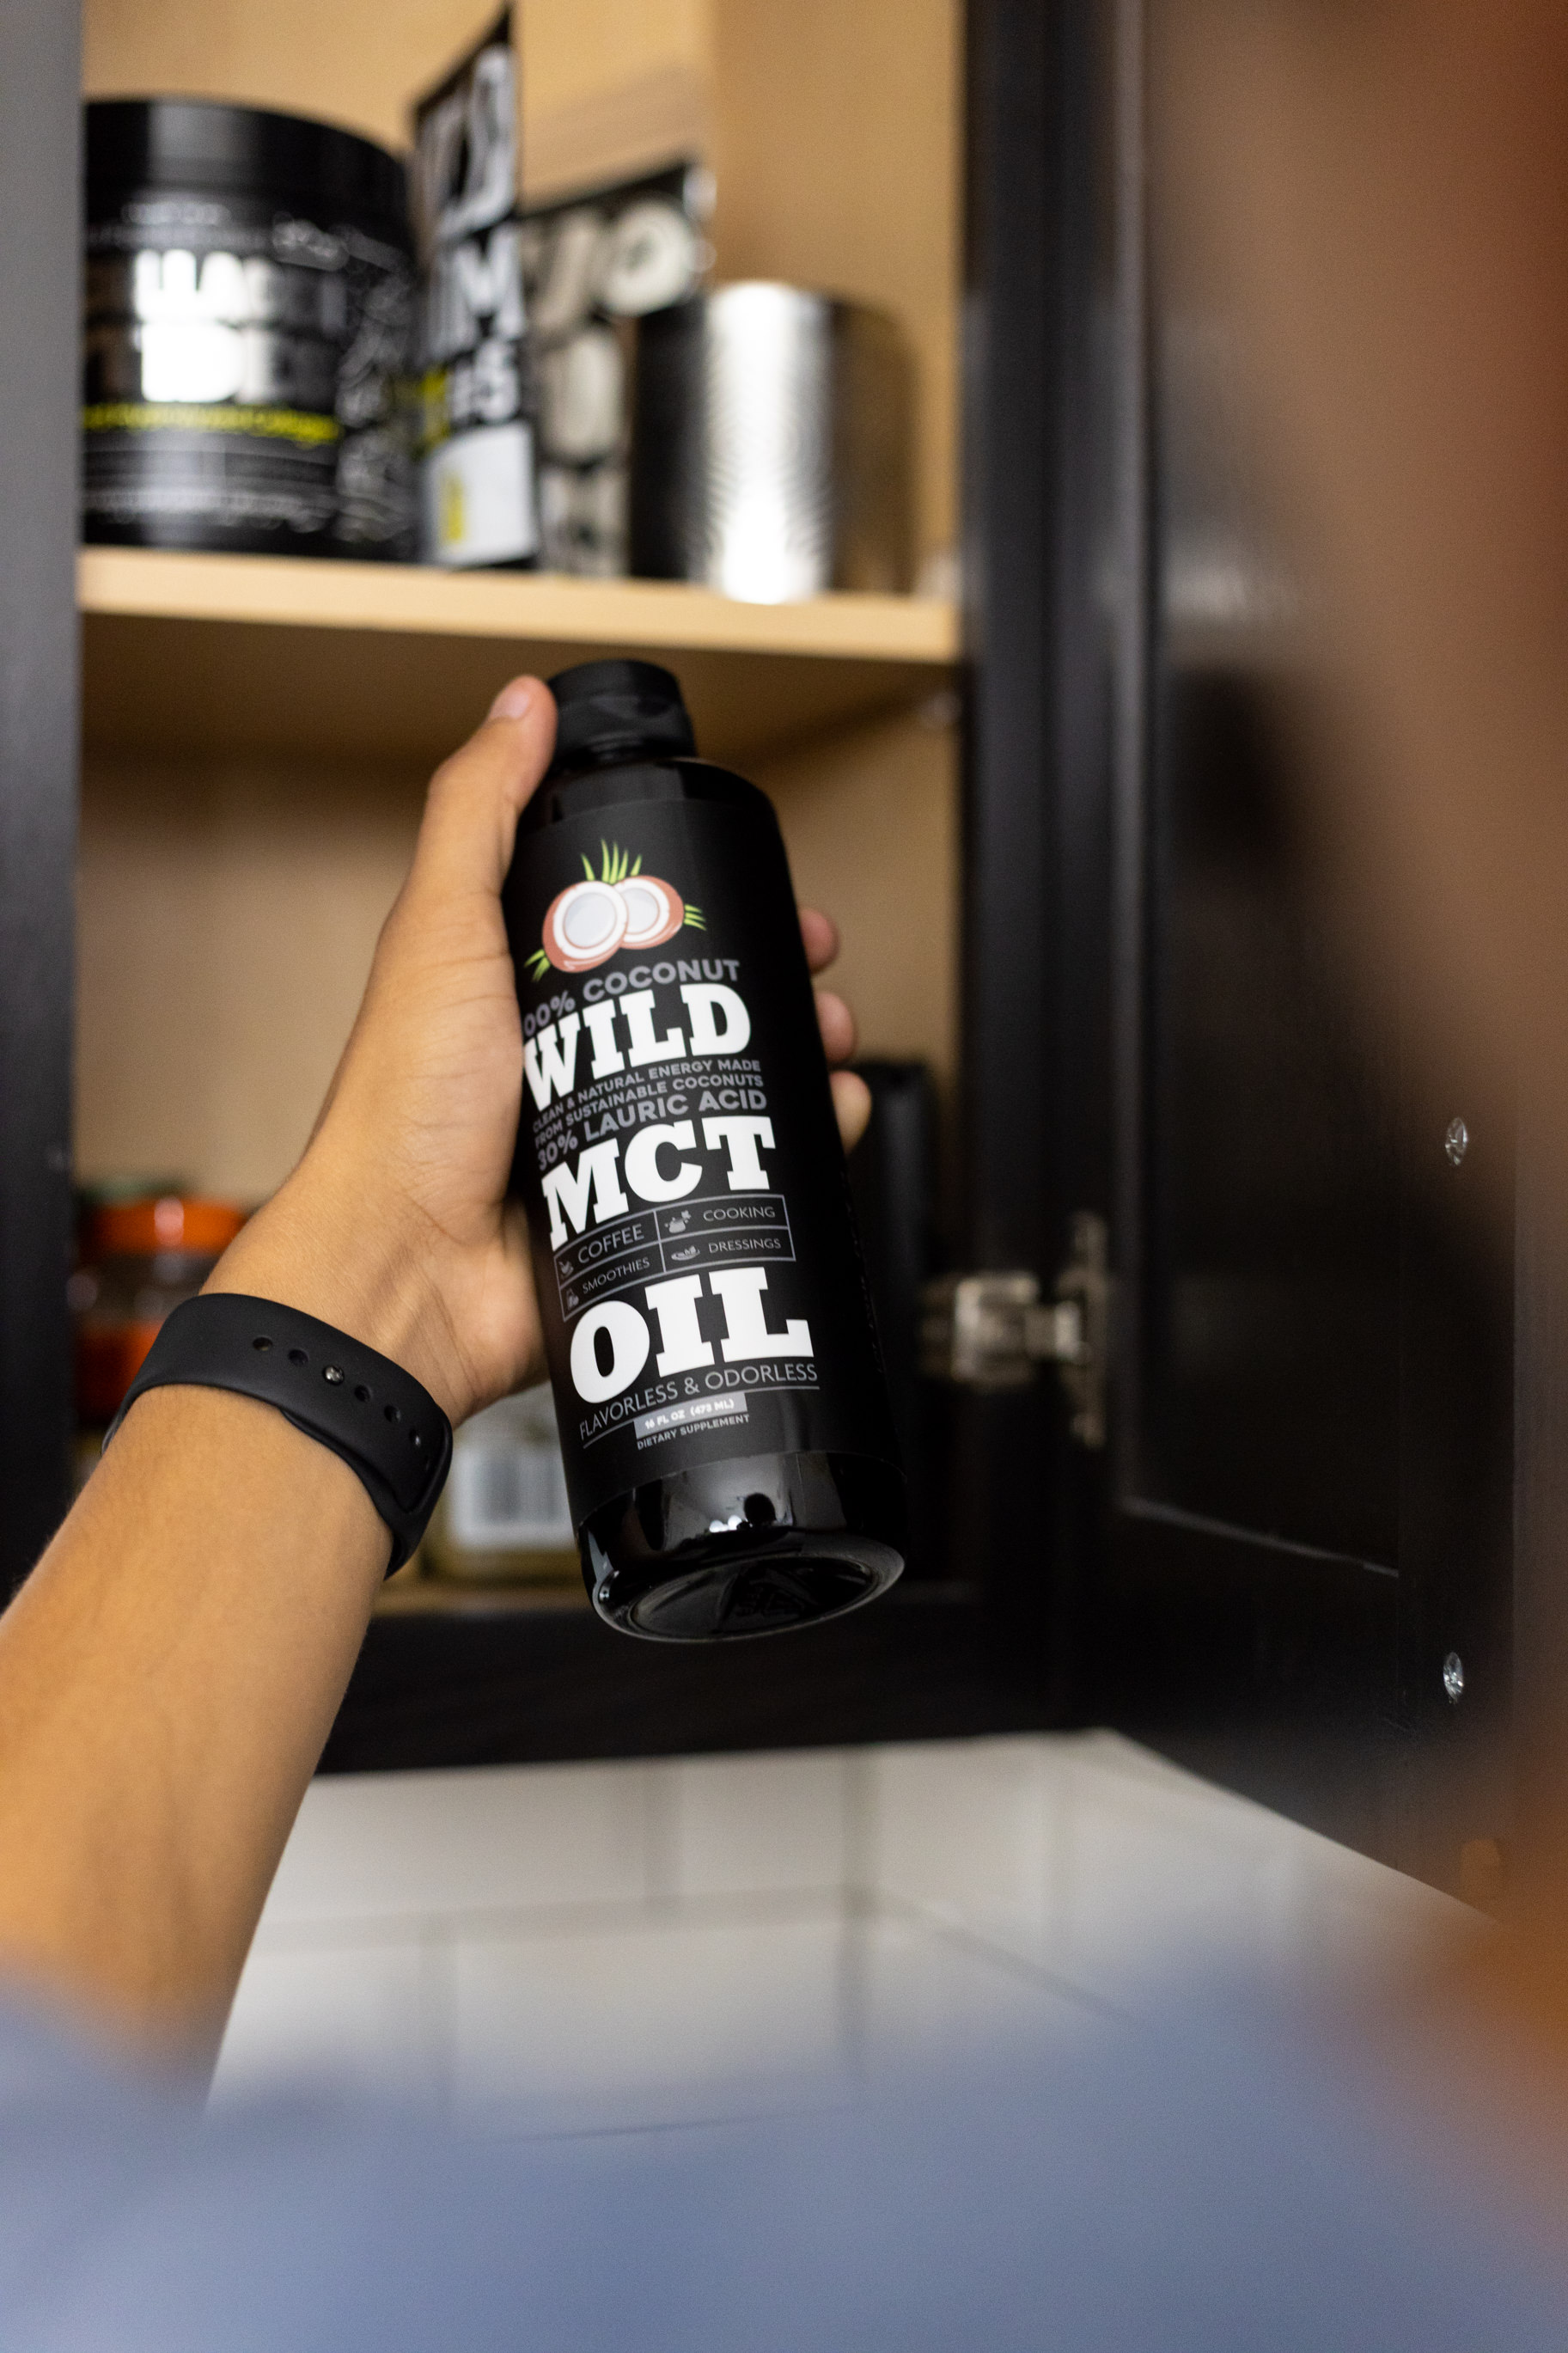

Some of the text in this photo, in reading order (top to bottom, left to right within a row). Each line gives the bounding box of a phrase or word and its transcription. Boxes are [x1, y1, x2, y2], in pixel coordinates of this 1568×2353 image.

[525, 959, 741, 1036] 00% COCONUT
[523, 983, 751, 1112] WILD
[533, 1059, 761, 1133] CLEAN & NATURAL ENERGY MADE
[534, 1074, 764, 1150] FROM SUSTAINABLE COCONUTS
[537, 1089, 767, 1172] 30% LAURIC ACID
[541, 1115, 776, 1252] MCT
[703, 1206, 776, 1222] COOKING
[577, 1224, 645, 1264] COFFEE
[582, 1257, 650, 1295] SMOOTHIES
[709, 1238, 782, 1254] DRESSINGS
[570, 1267, 815, 1404] OIL
[579, 1363, 818, 1441] FLAVORLESS & ODORLESS
[637, 1414, 750, 1451] DIETARY SUPPLEMENT
[644, 1398, 735, 1430] 16 FL OZ (473 ML)
